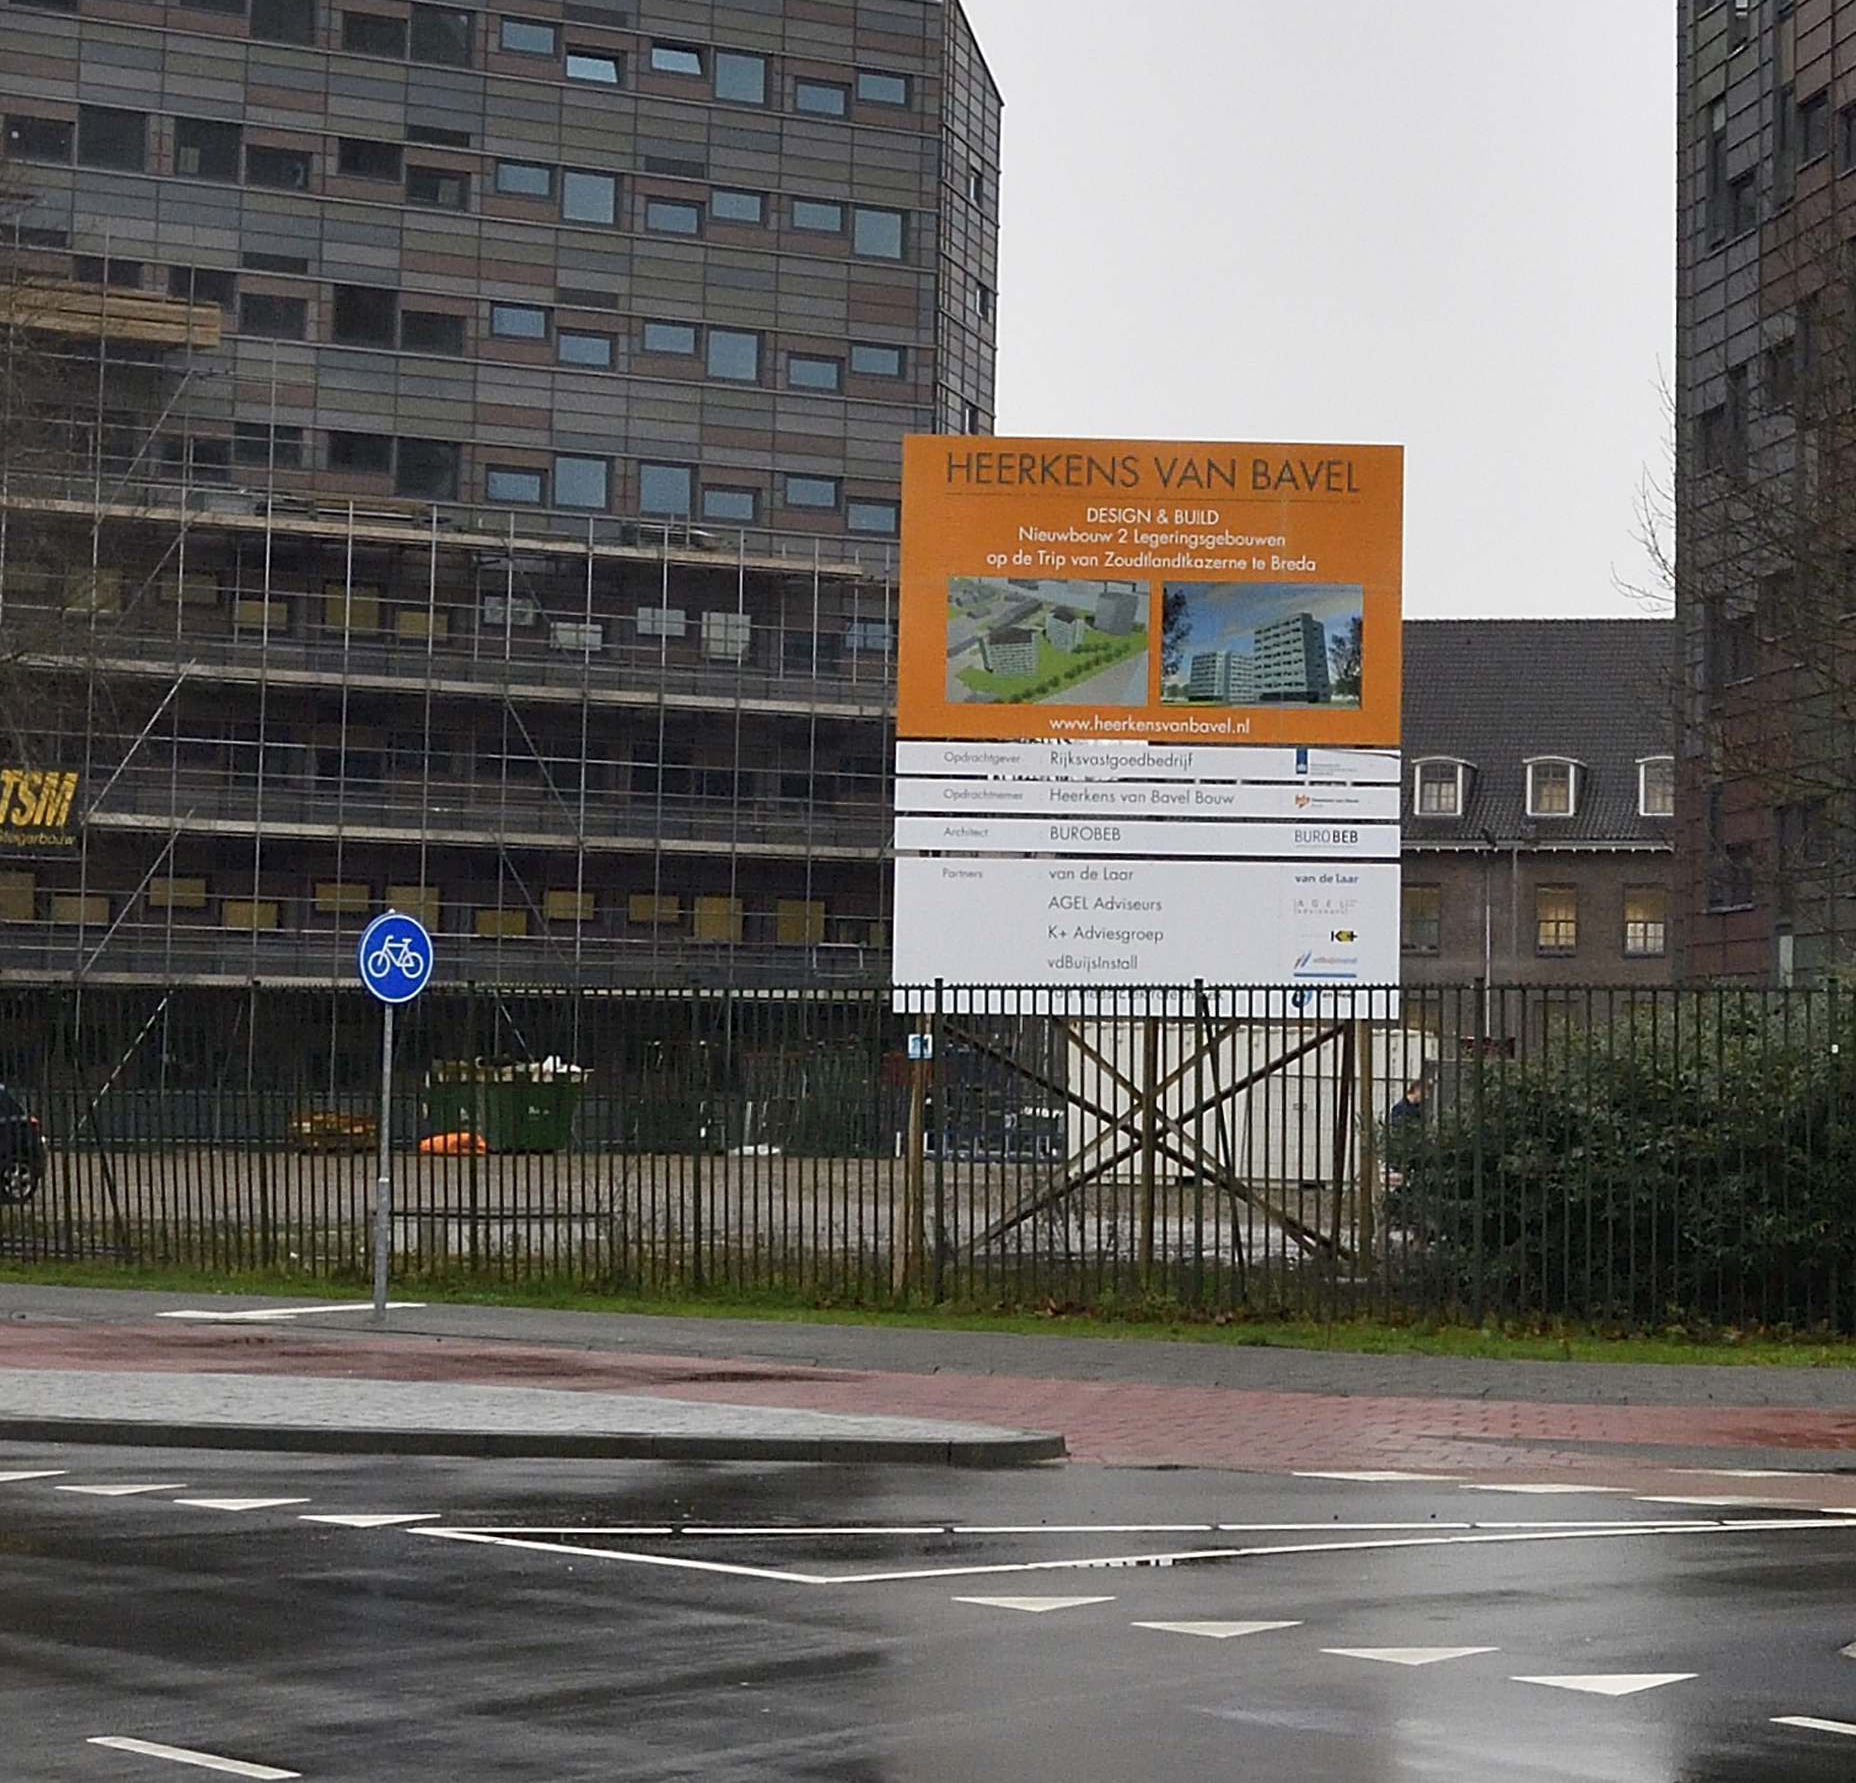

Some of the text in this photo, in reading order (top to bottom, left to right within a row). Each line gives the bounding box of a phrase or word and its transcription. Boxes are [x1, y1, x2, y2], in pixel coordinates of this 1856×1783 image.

[947, 452, 1361, 493] HEERKENS VAN BAVEL
[1086, 507, 1220, 526] DESIGN & BUILD
[1018, 526, 1286, 550] Nieuwbouw 2 Legeringsgebouwen
[986, 549, 1316, 571] op de Trip van Zoudtlandtkazerne te Breda
[1049, 715, 1250, 735] www.heerkensvanbavel.nl
[943, 751, 1021, 765] Opdrachtgever
[1050, 751, 1194, 770] Rijksvastgoedbedrijf
[1049, 788, 1235, 805] Heerkens van Bavel Bouw
[943, 826, 989, 838] Architect
[1050, 826, 1121, 842] BUROBEB
[942, 868, 983, 879] Partners
[1048, 866, 1134, 881] van de Laar
[1295, 875, 1316, 883] van
[1319, 873, 1335, 883] de
[1048, 896, 1162, 912] AGEL Adviseurs
[1048, 926, 1164, 944] K+ Adviesgroep
